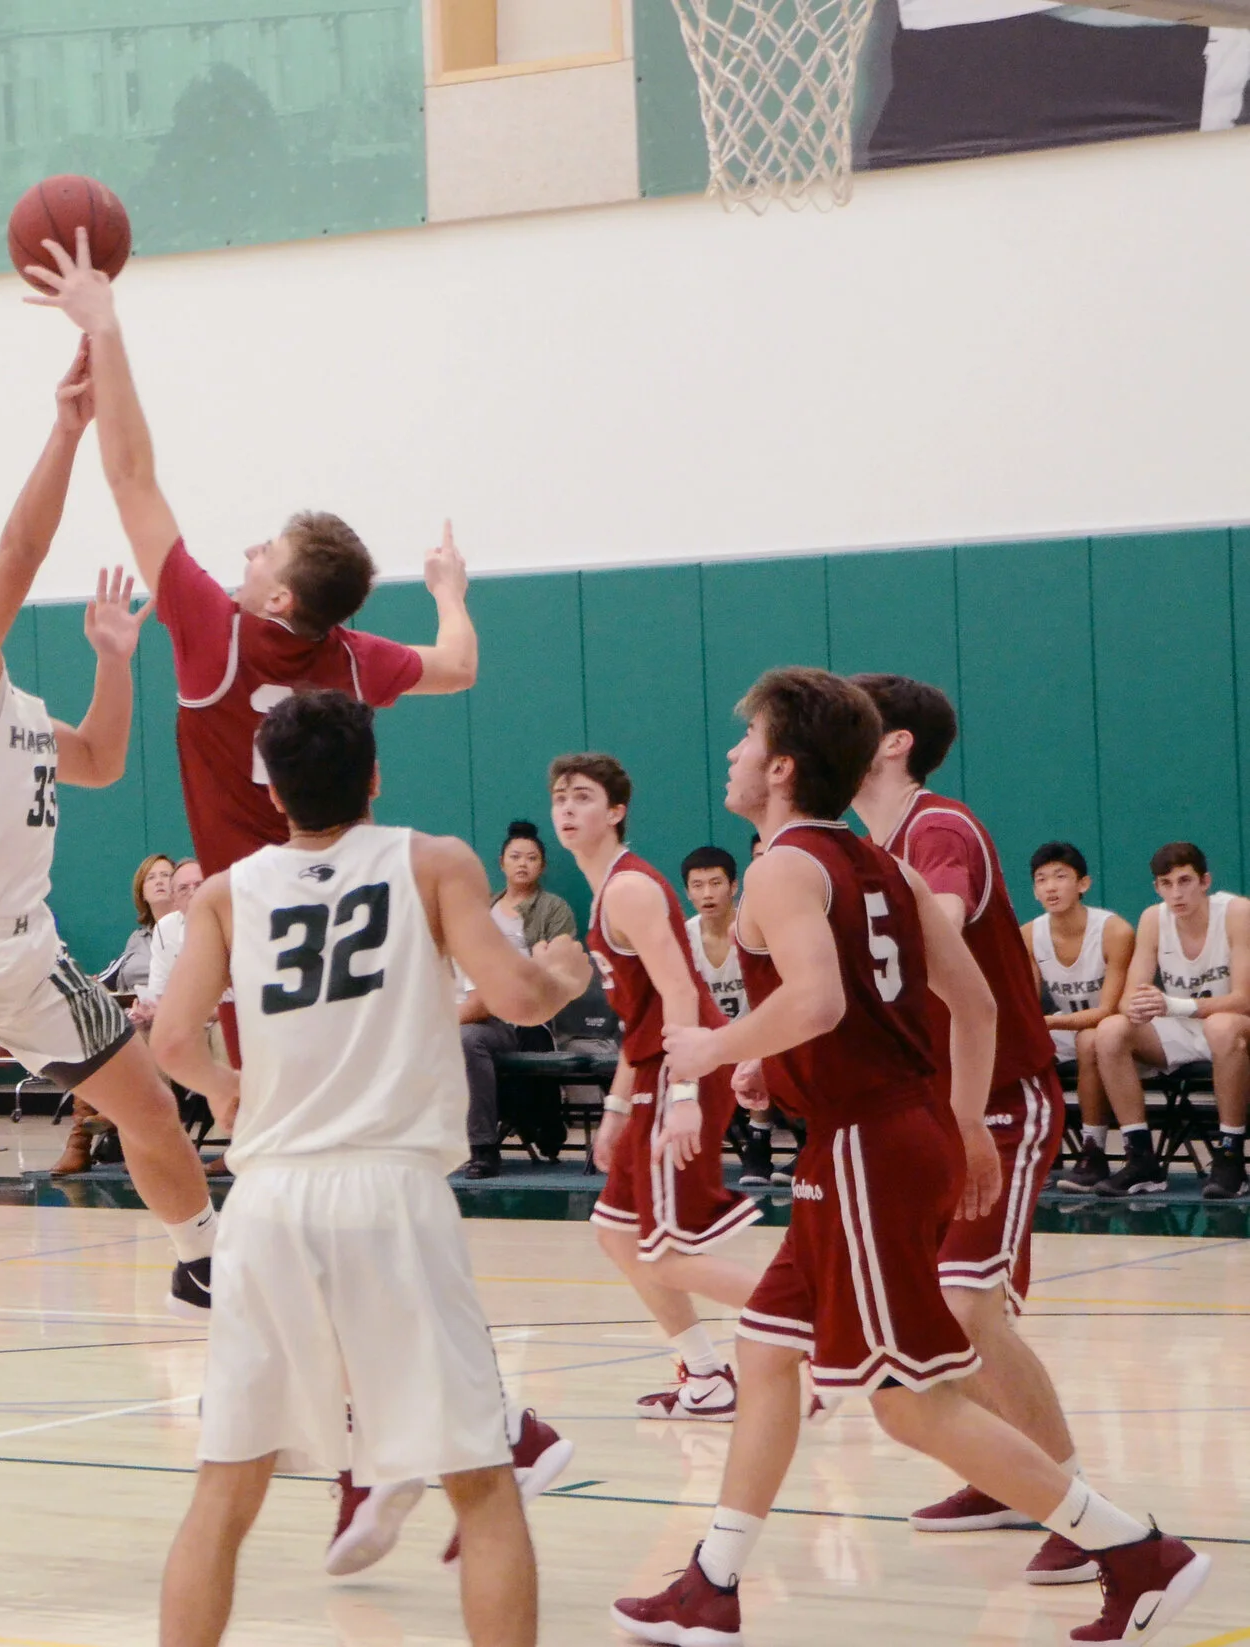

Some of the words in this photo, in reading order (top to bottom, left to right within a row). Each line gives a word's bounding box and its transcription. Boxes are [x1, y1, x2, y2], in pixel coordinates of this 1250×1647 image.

[261, 881, 390, 1015] 32
[704, 979, 744, 994] RKE
[863, 891, 903, 1003] 5
